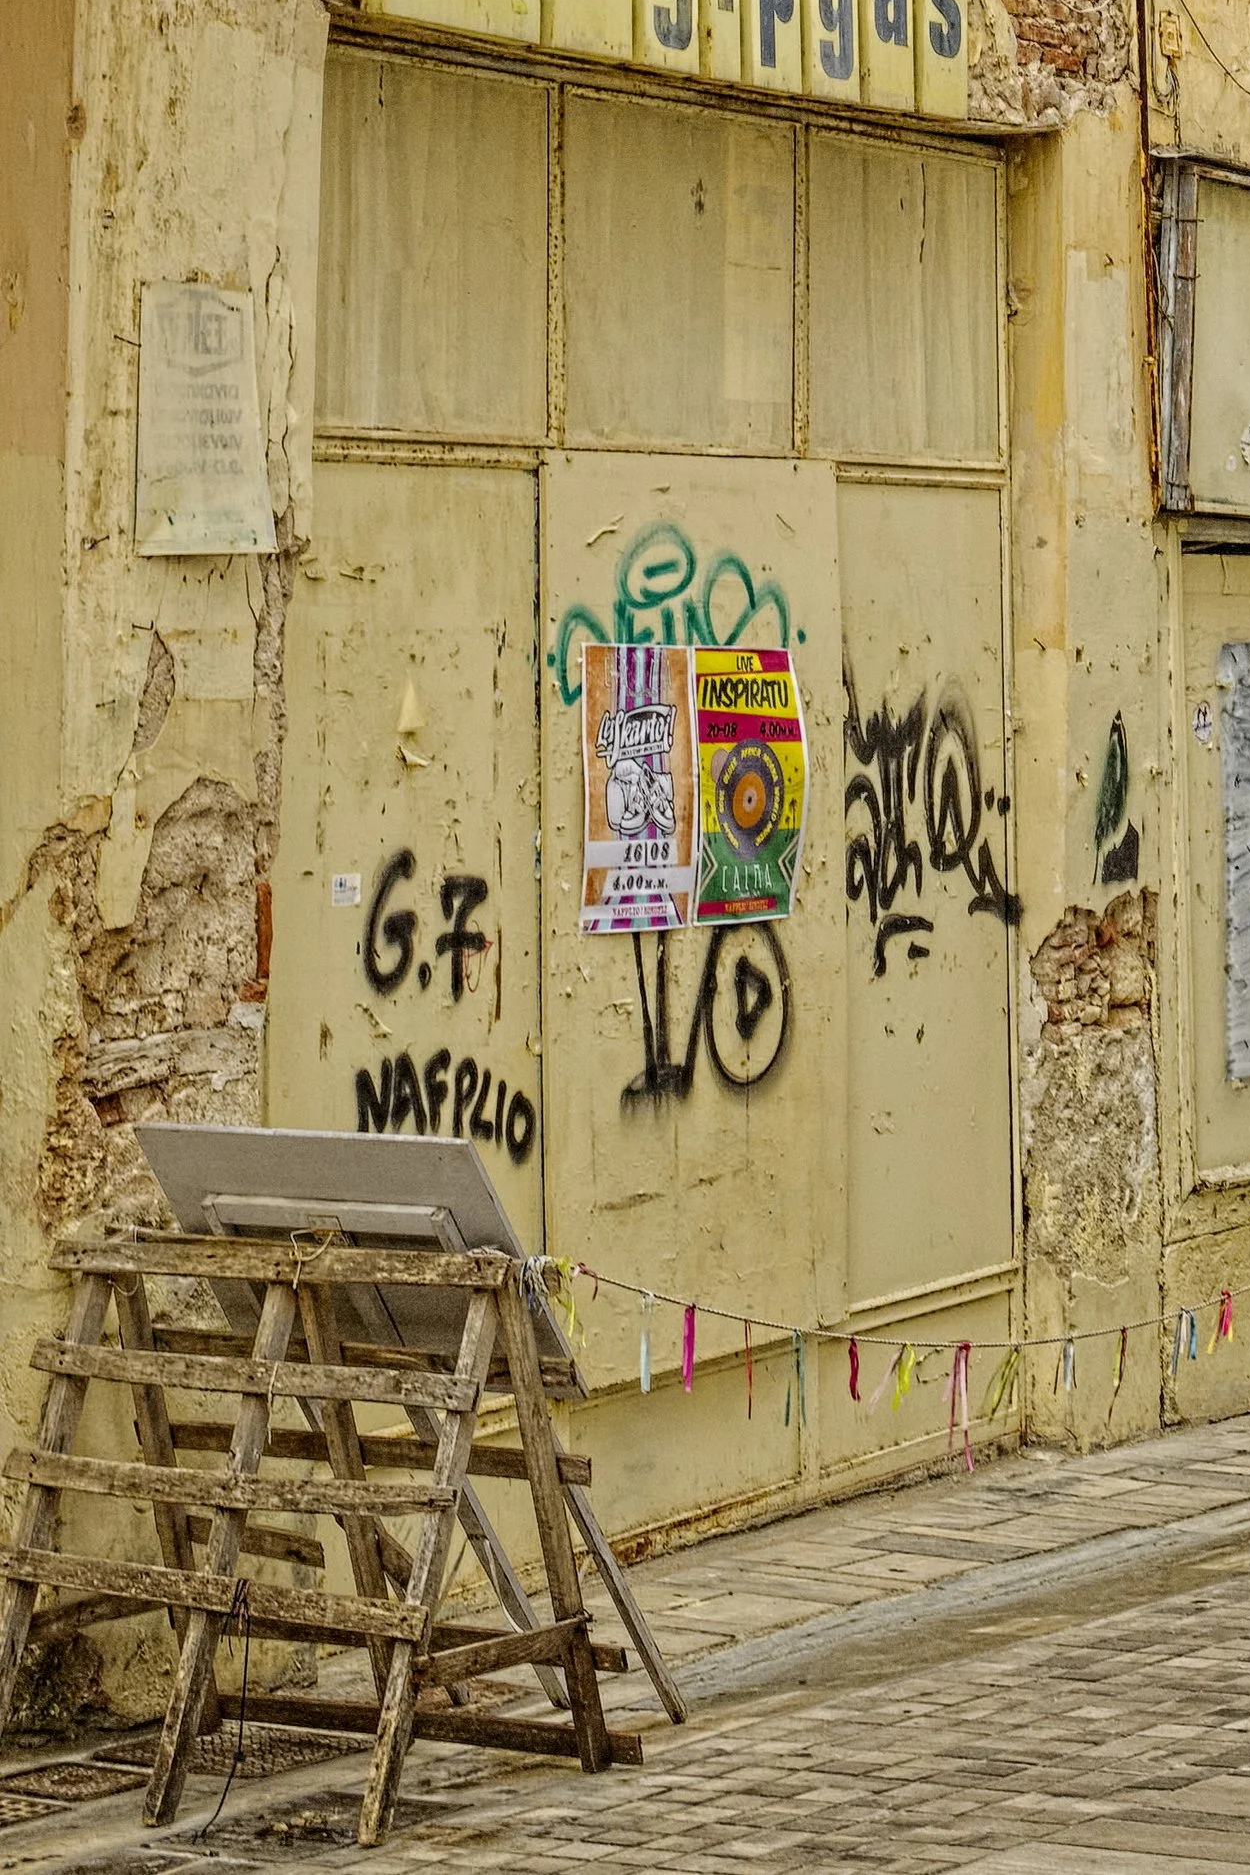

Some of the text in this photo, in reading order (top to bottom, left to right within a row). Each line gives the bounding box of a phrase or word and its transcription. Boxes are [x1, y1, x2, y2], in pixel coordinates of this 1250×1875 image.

[736, 655, 754, 672] LIVE
[701, 677, 789, 710] INSPIRATU
[707, 722, 737, 739] 20-08
[354, 1048, 536, 1167] NAFPLIO
